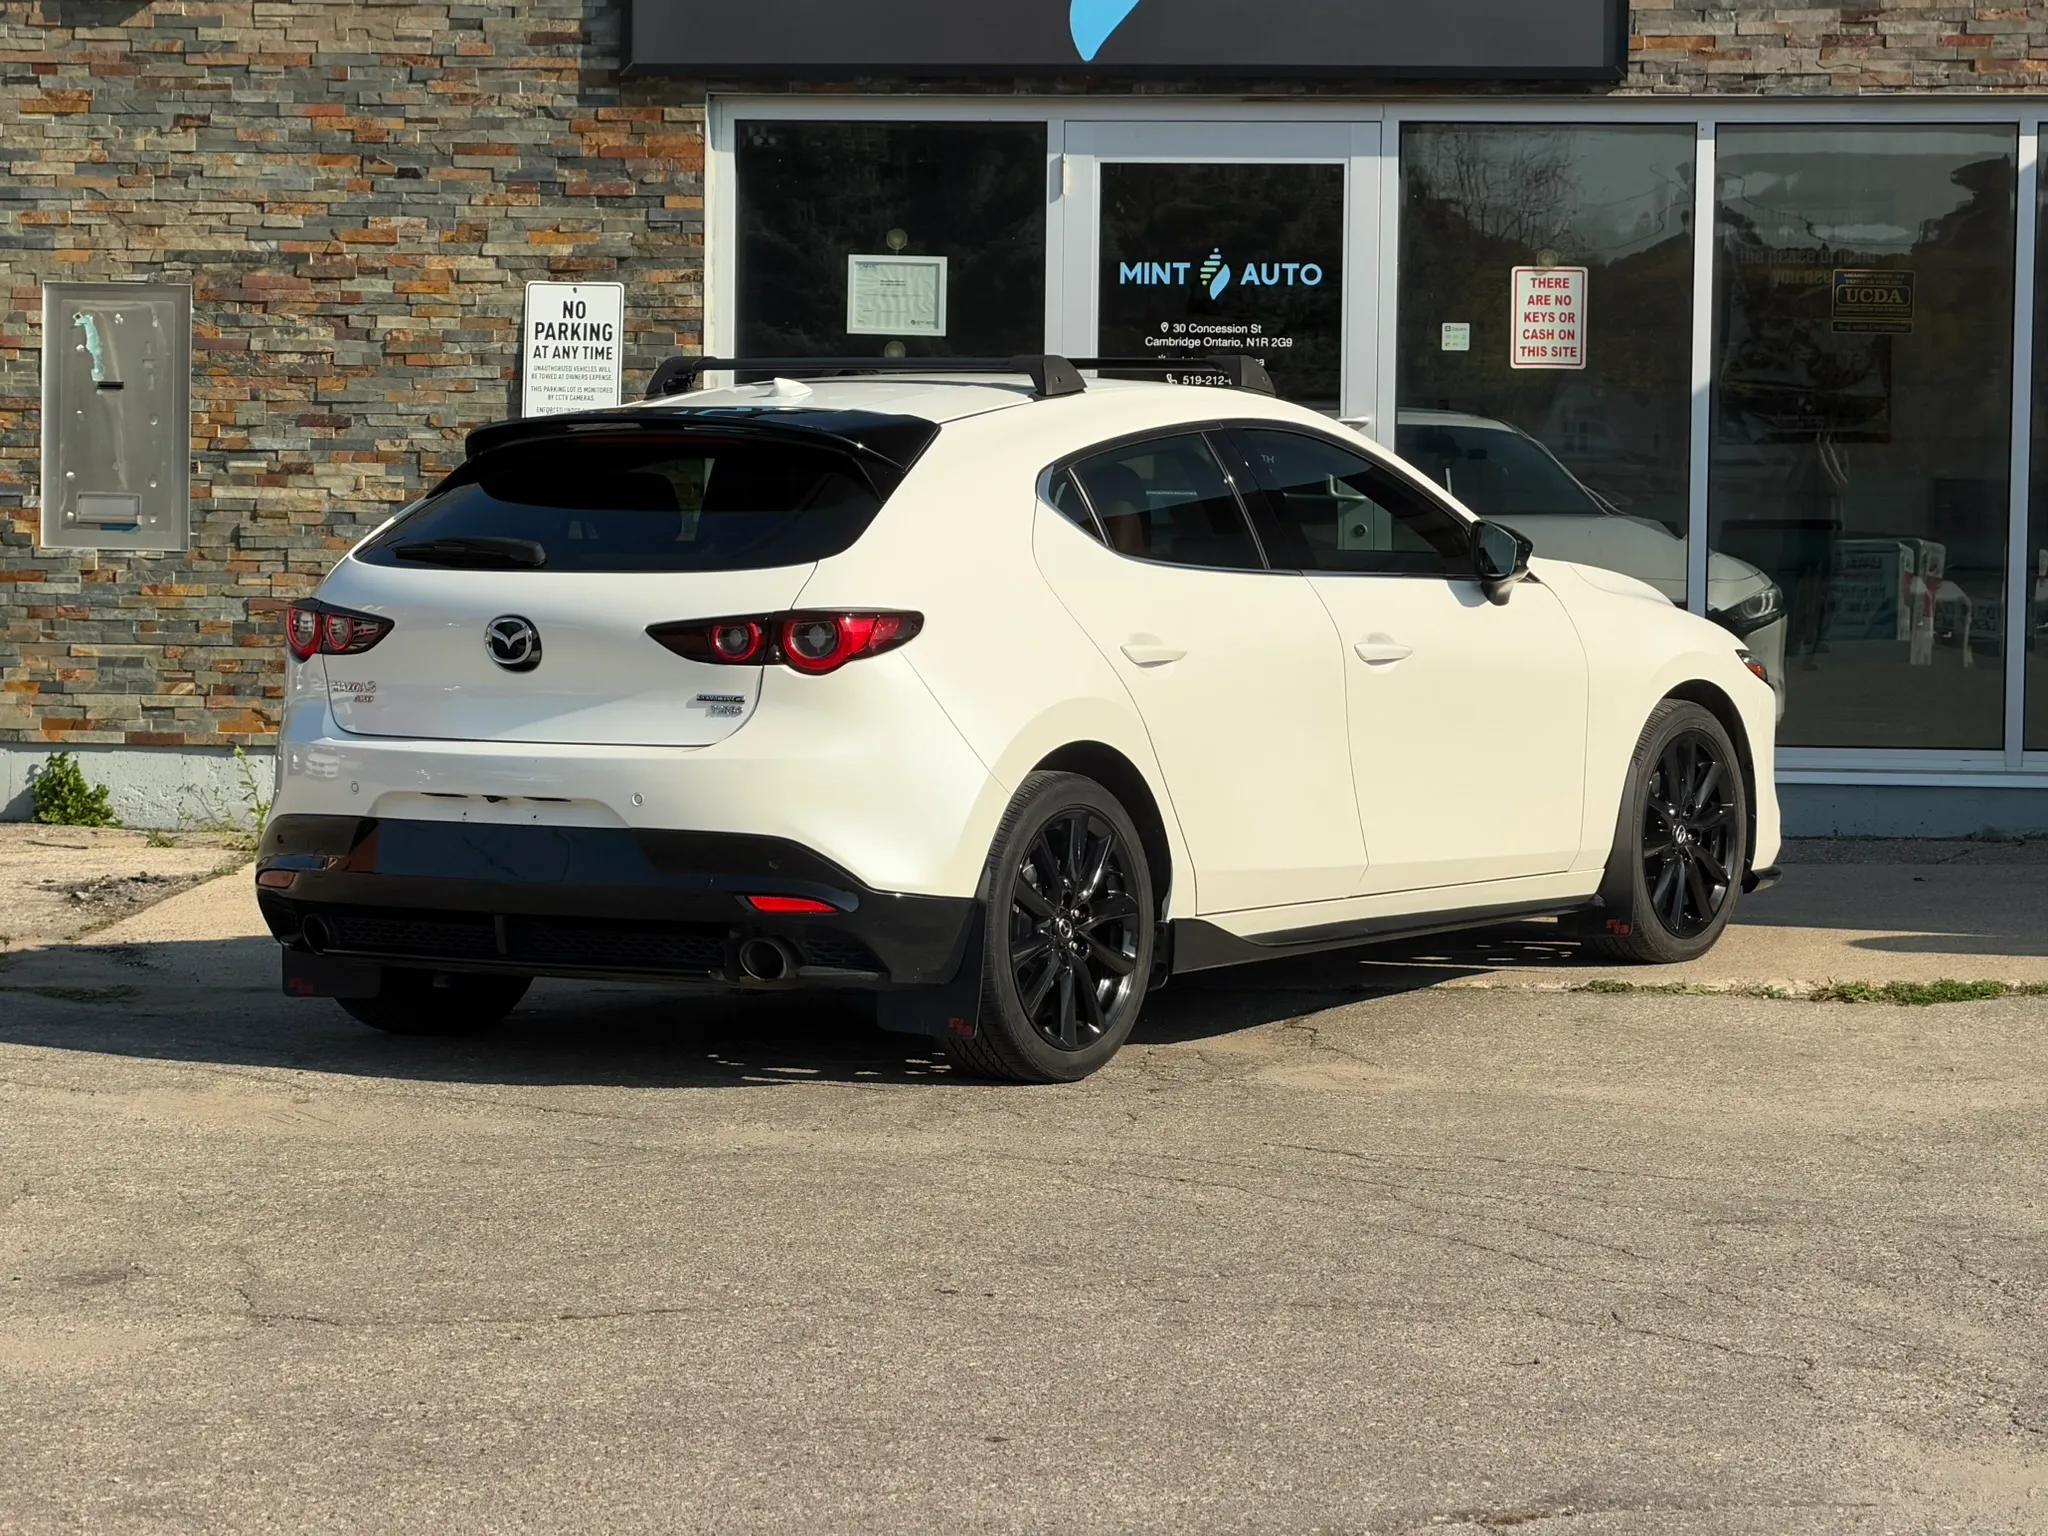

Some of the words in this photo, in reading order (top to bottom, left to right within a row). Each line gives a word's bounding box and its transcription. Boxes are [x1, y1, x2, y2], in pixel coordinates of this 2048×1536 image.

[1119, 261, 1191, 285] MINT
[1240, 262, 1323, 286] AUTO
[1530, 278, 1570, 288] THERE
[1527, 294, 1551, 306] ARE
[1554, 295, 1572, 306] NO
[1845, 288, 1903, 303] UCDA
[562, 300, 586, 319] NO
[1524, 312, 1555, 323] KEYS
[1559, 312, 1576, 324] OR
[534, 322, 613, 342] PARKING
[1172, 323, 1186, 333] 30
[1188, 323, 1248, 334] Concession
[1250, 323, 1262, 334] St
[1522, 329, 1555, 340] CASH
[1558, 329, 1575, 340] ON
[1145, 336, 1201, 348] Cambridge
[1203, 337, 1244, 348] Ontario,
[1246, 337, 1269, 347] N1R
[1271, 337, 1293, 348] 2G9
[533, 345, 549, 359] AT
[552, 345, 579, 359] ANY
[582, 346, 613, 360] TIME
[1520, 346, 1547, 357] THIS
[1551, 346, 1577, 358] SITE
[1182, 376, 1233, 385] 519-212-
